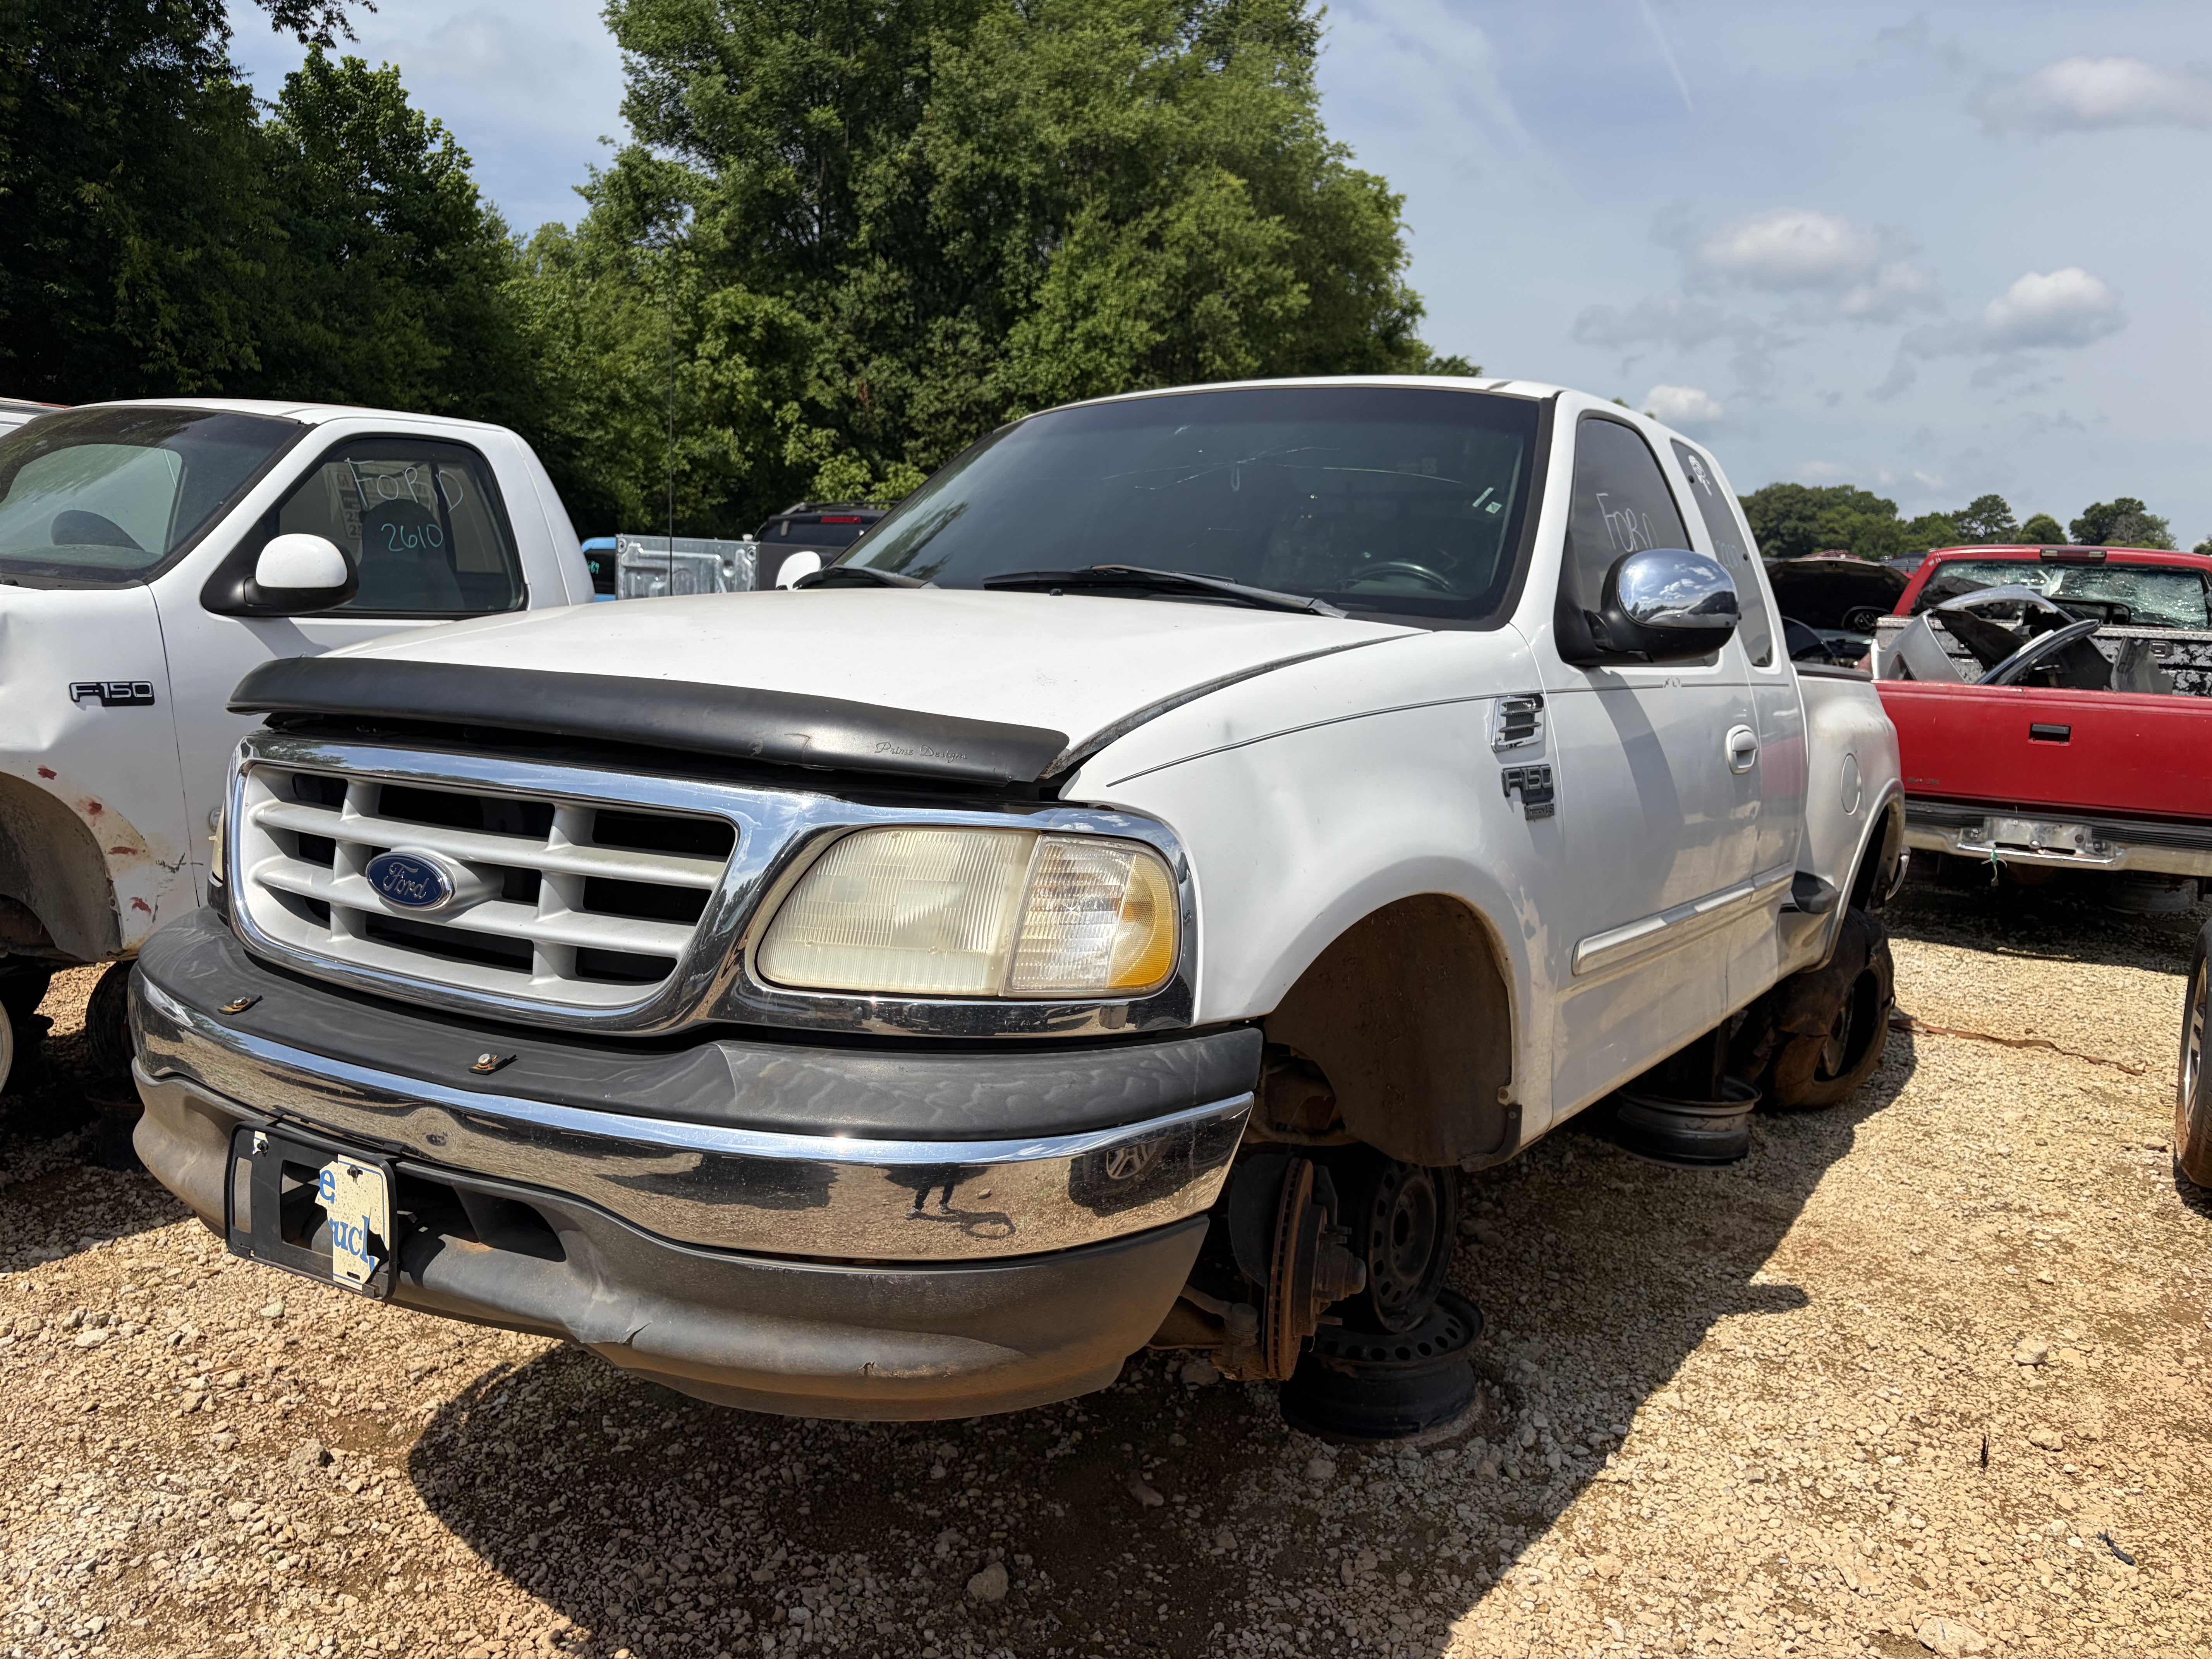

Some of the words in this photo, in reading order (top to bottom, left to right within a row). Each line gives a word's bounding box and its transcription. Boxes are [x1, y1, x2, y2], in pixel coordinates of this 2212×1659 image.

[344, 457, 463, 514] FORD
[1596, 493, 1659, 552] FORD
[381, 523, 443, 552] 2610
[70, 682, 153, 701] F-150
[874, 742, 914, 756] Prime
[919, 745, 968, 763] Designs
[1504, 765, 1553, 794] F-150
[383, 862, 430, 900] Ford
